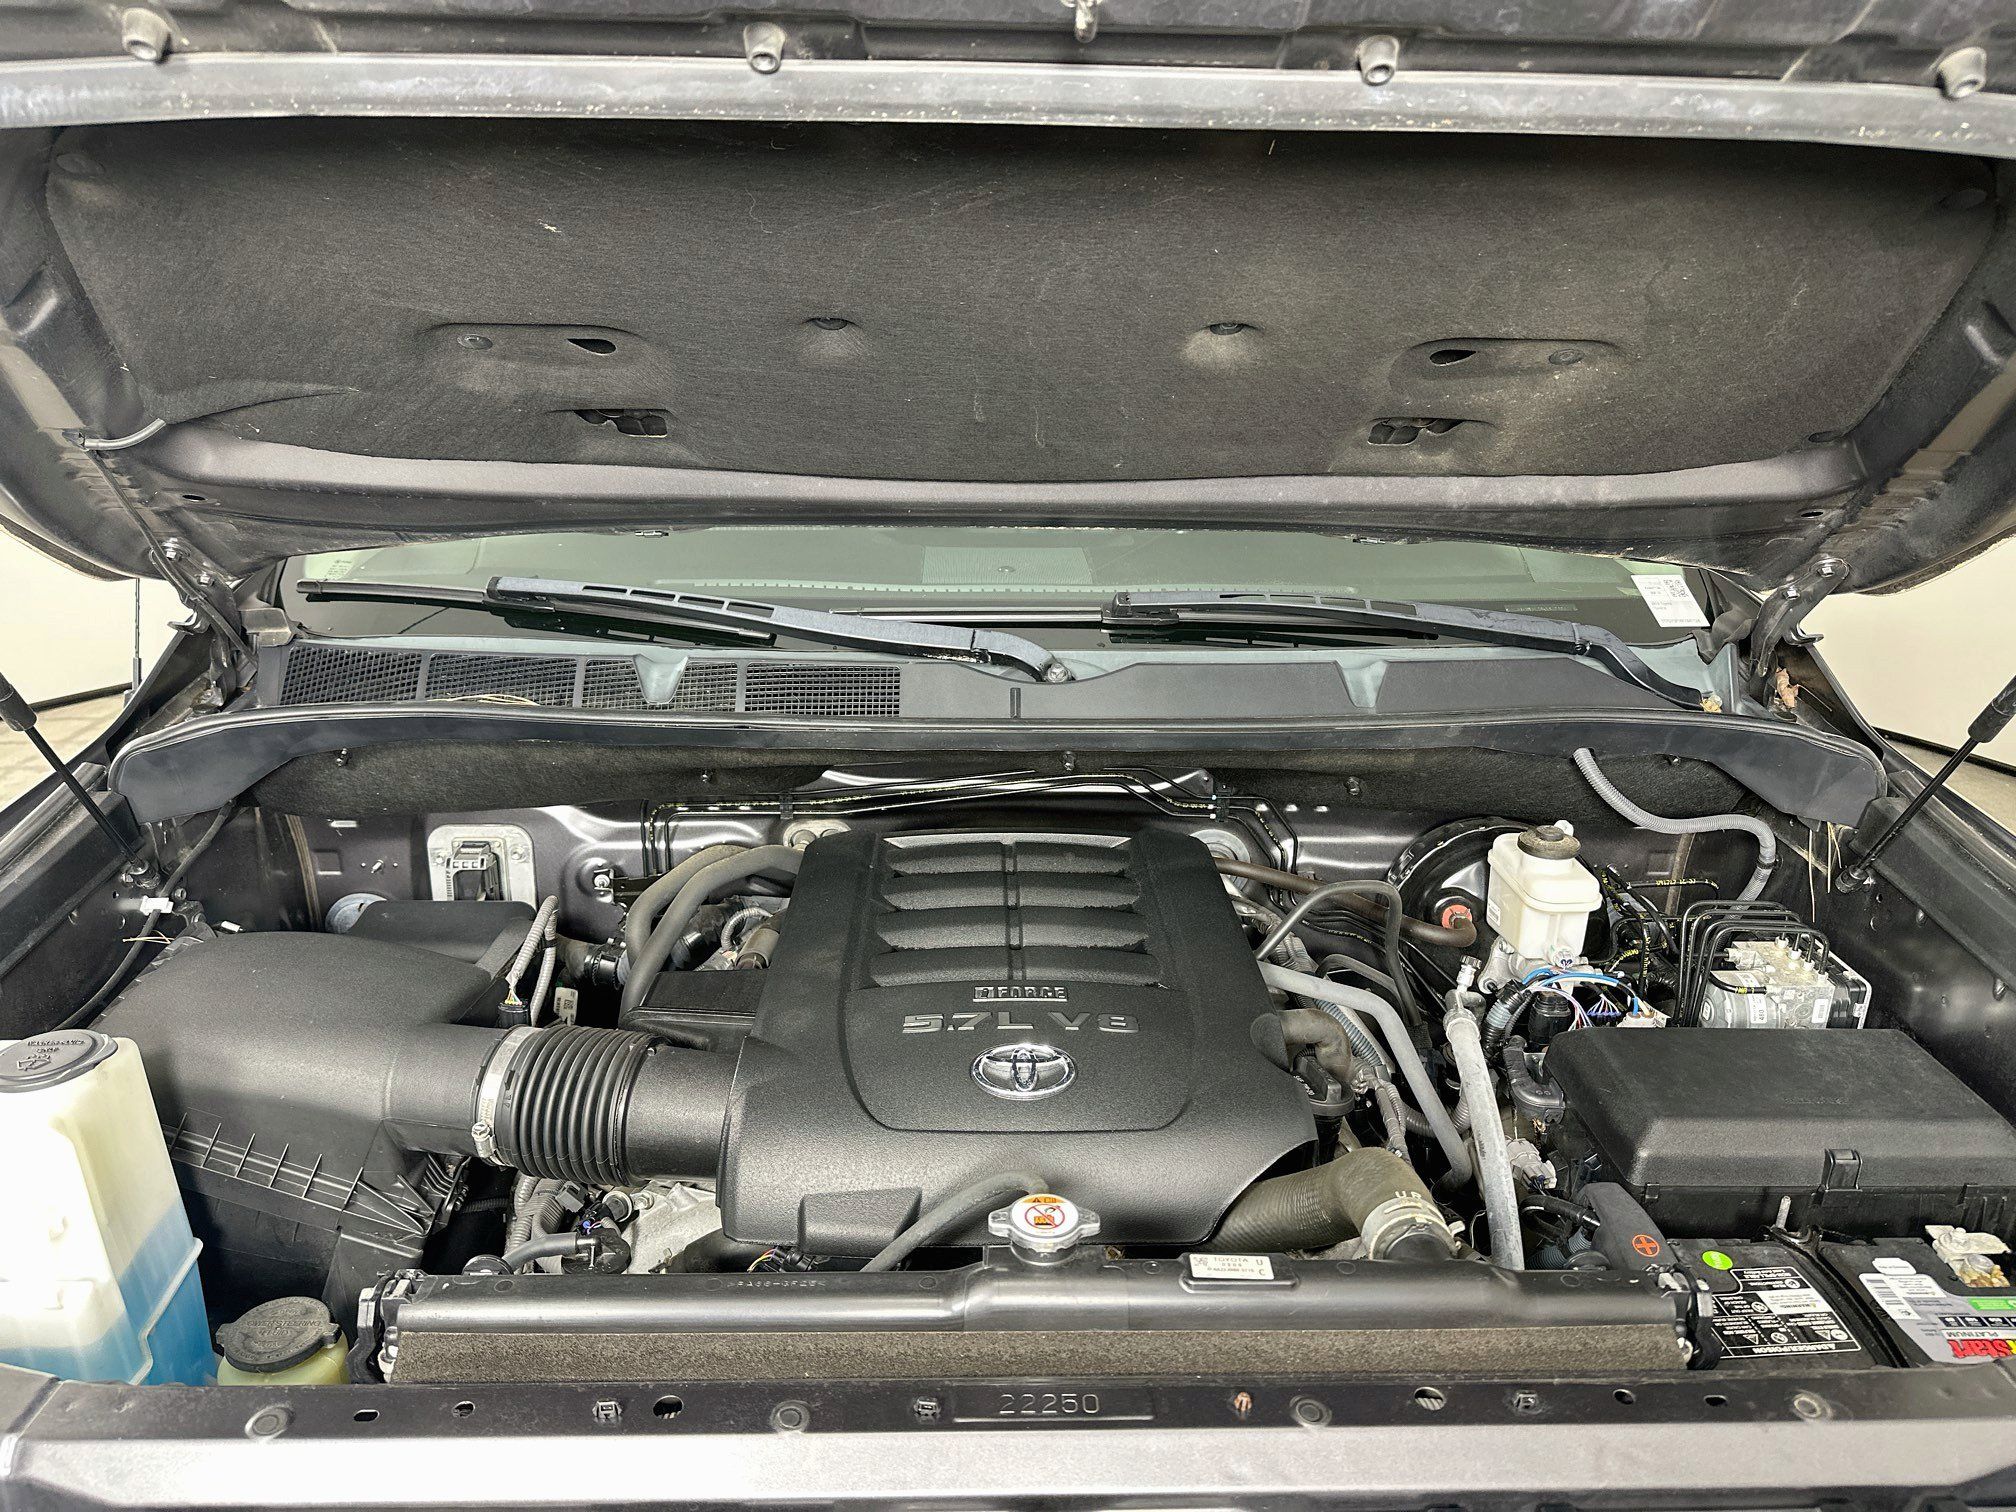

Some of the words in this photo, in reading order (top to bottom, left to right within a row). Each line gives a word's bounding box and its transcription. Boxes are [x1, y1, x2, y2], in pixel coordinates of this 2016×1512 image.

[902, 1011, 1034, 1034] 5.7L
[1049, 1011, 1140, 1034] V8
[998, 1392, 1101, 1415] 22250
